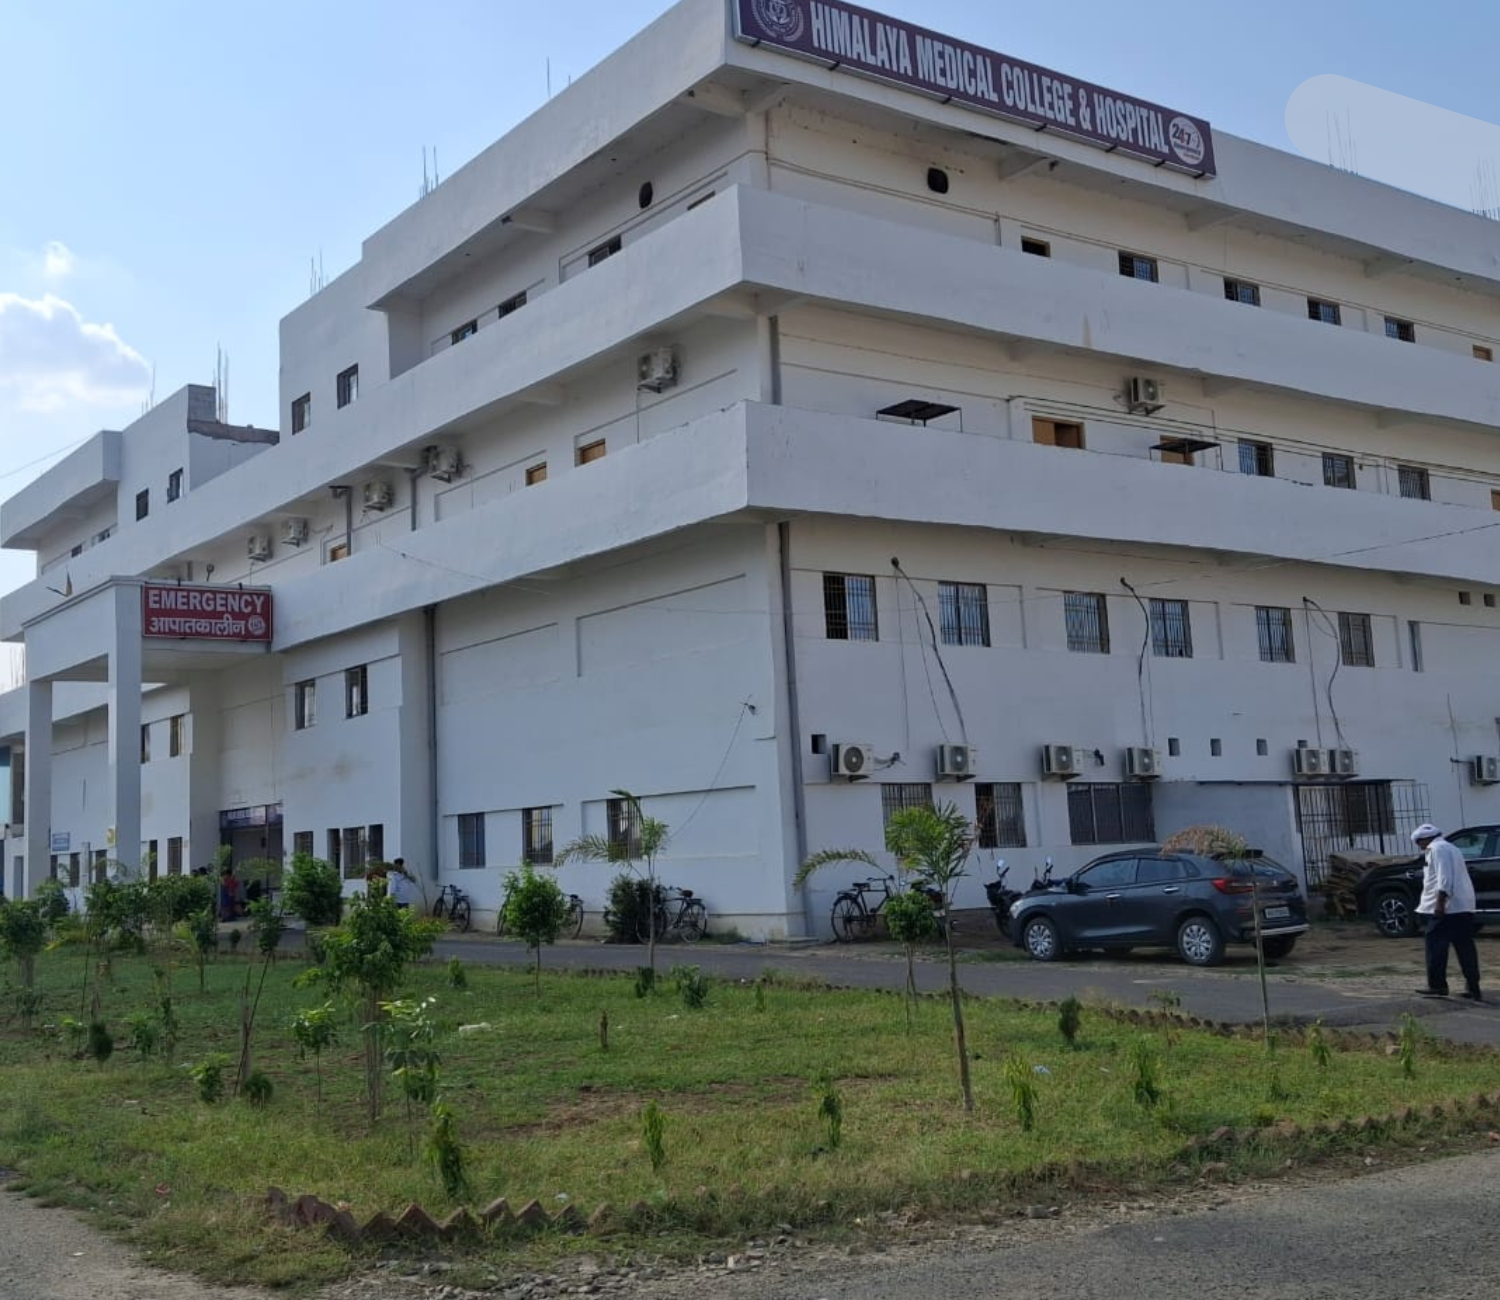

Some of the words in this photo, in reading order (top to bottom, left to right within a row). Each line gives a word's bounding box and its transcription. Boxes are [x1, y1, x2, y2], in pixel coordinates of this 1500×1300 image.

[810, 1, 912, 77] HIMALAYA
[915, 34, 999, 102] MEDICAL
[1000, 63, 1076, 126] COLLEGE
[1078, 88, 1092, 132] &
[1094, 92, 1169, 153] HOSPITAL
[148, 589, 264, 613] EMERGENCY
[149, 613, 246, 635] आपातकालीन
